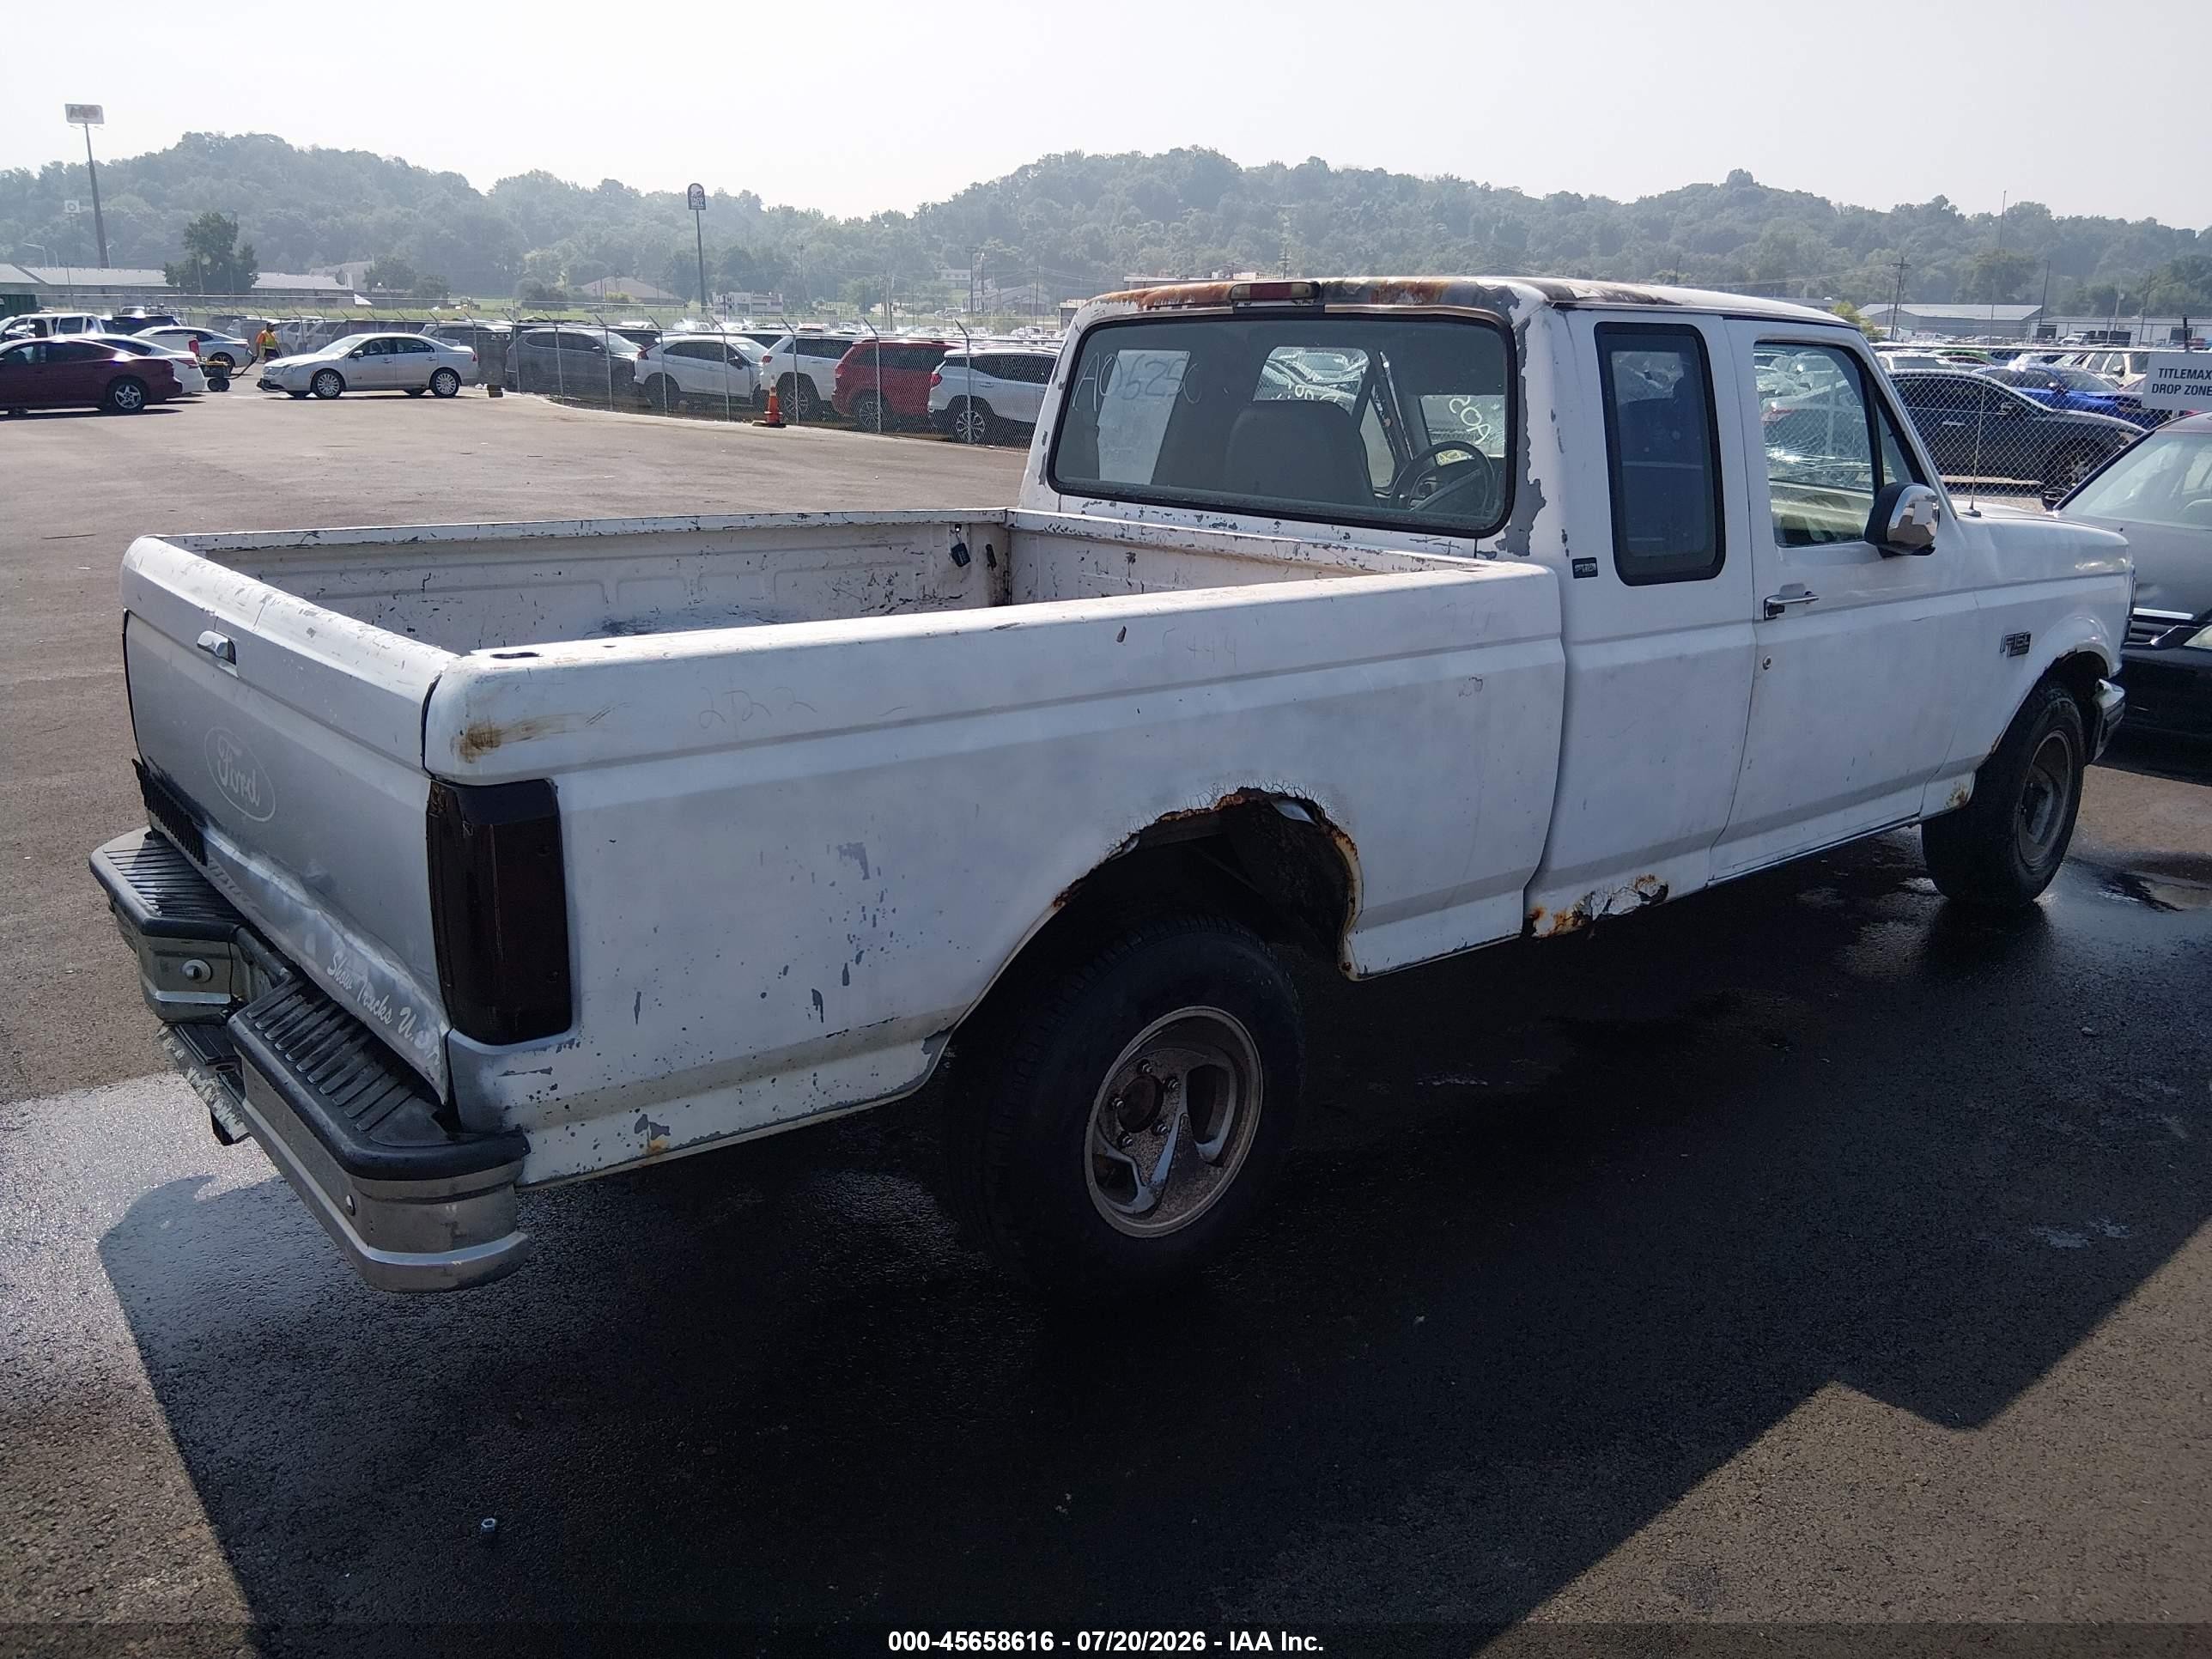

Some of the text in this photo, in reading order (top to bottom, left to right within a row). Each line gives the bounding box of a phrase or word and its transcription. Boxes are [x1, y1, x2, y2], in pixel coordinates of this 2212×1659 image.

[2158, 368, 2212, 380] TITLEMAX
[2151, 383, 2212, 396] DROP ZONE
[216, 735, 261, 807] Ford
[326, 950, 353, 990] Show
